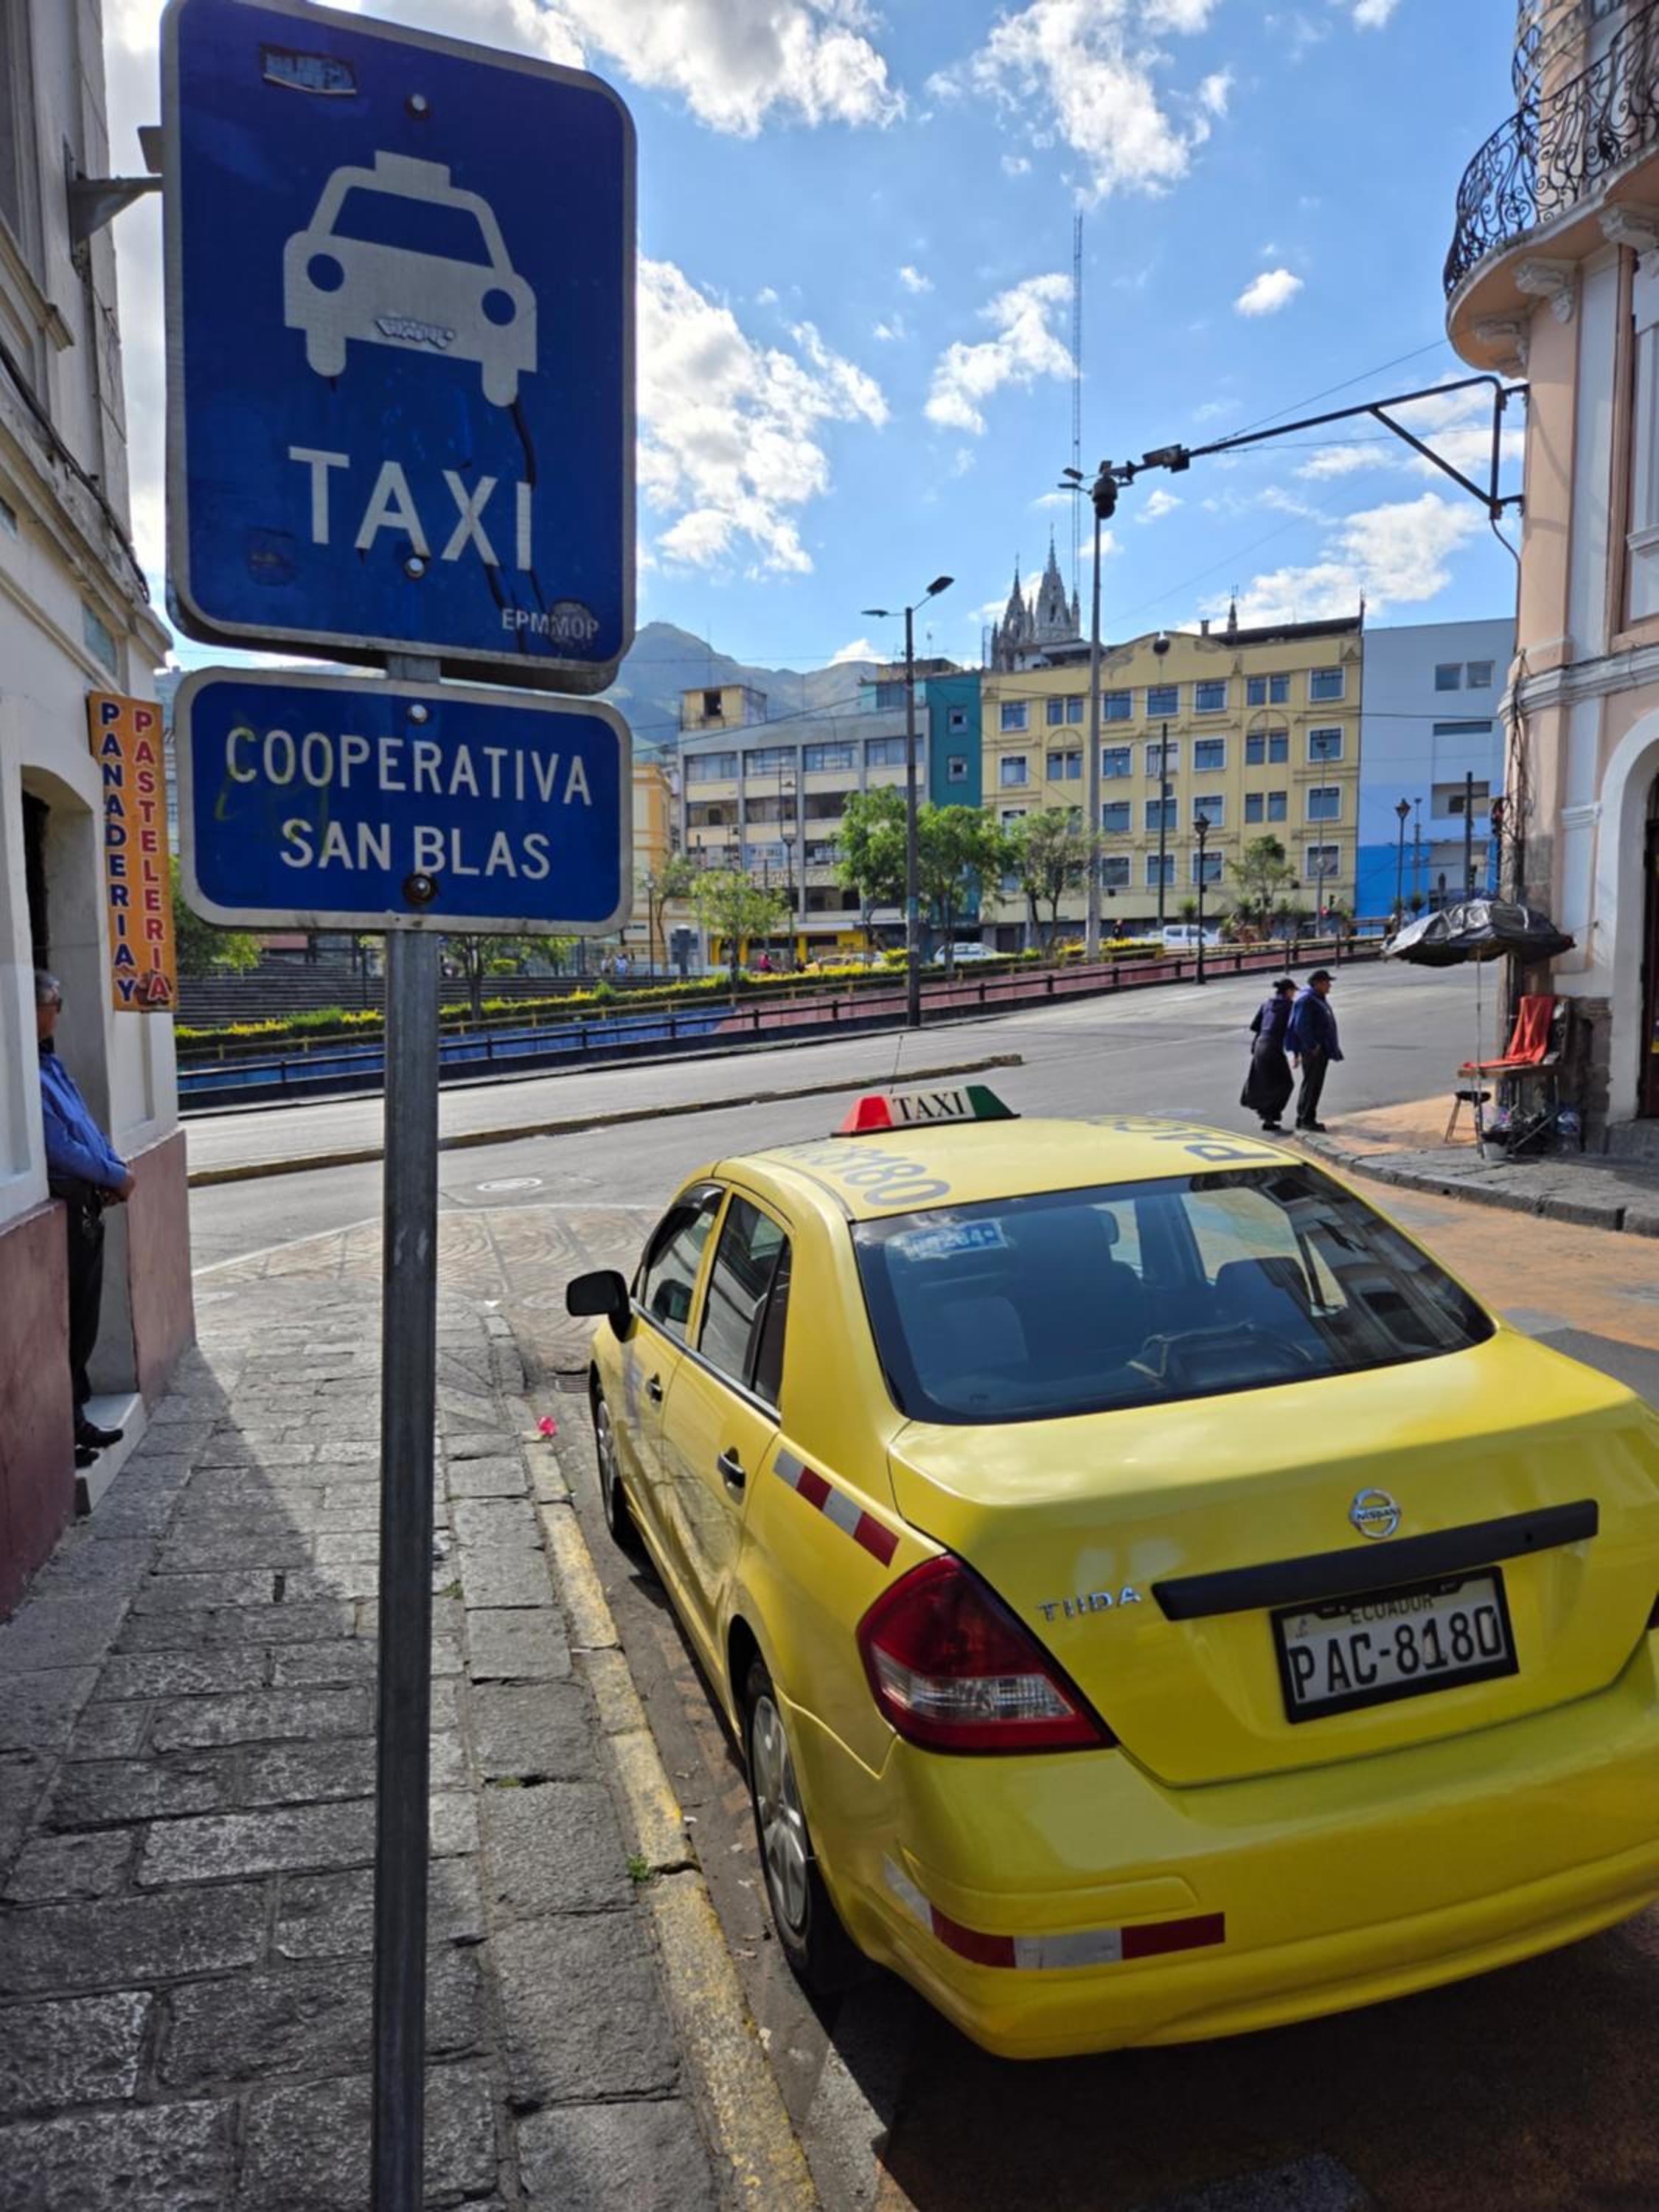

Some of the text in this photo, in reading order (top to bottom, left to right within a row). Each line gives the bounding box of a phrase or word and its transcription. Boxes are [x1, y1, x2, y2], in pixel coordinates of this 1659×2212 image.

[288, 446, 532, 571] TAXI
[501, 608, 599, 640] EPMMOP
[226, 726, 593, 806] COOPERATIVA
[133, 709, 170, 1001] PASTELERIA
[280, 818, 551, 880] SAN BLAS
[893, 1092, 967, 1121] TAXI
[1038, 1586, 1142, 1621] TIIDA
[1349, 1593, 1434, 1624] ECUADOR
[1289, 1604, 1503, 1700] PAC-8180
